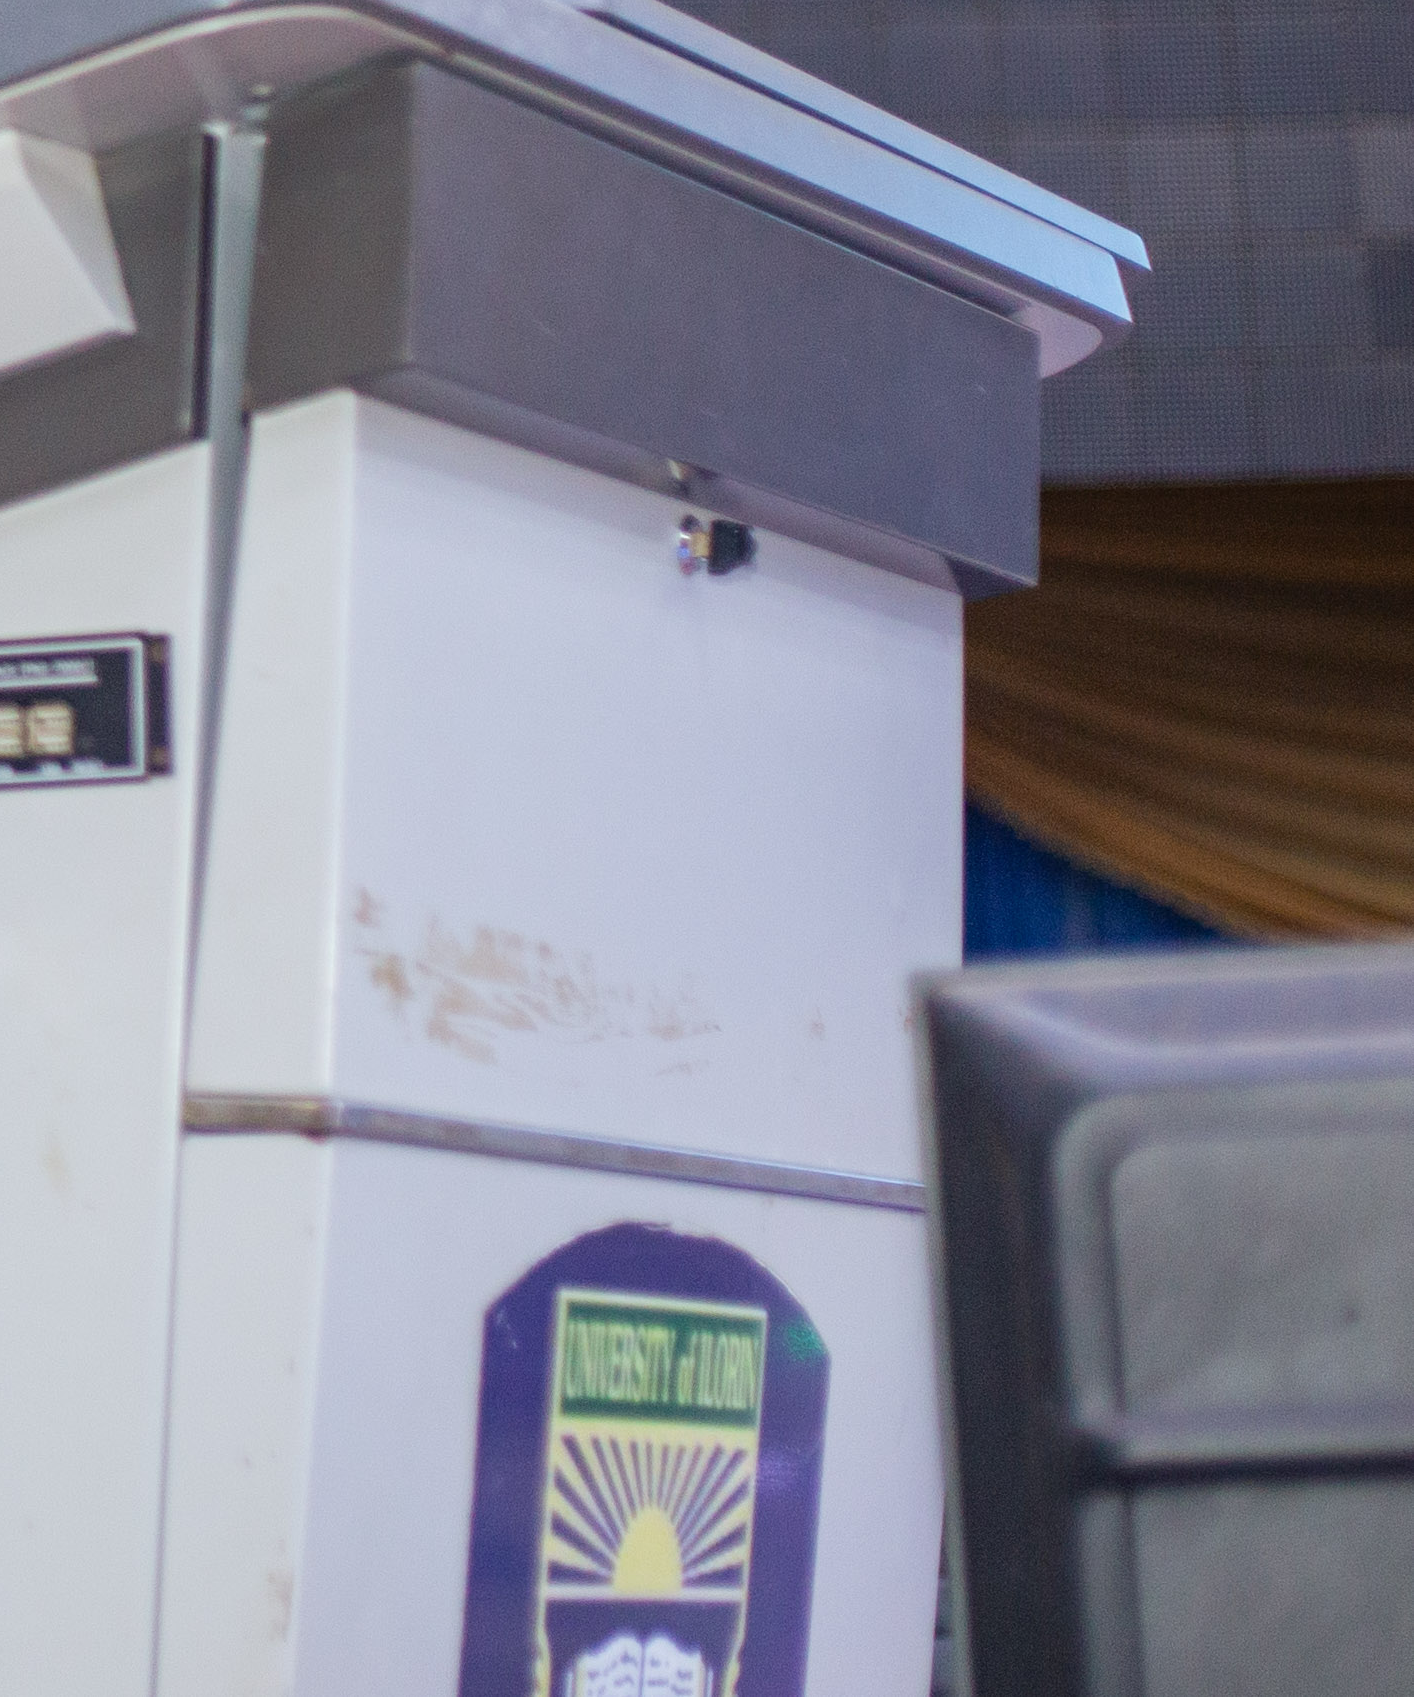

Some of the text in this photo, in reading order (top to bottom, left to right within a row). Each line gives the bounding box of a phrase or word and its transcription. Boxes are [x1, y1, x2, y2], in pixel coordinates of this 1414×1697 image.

[565, 1320, 760, 1410] UNIVERSITY of ILORIN
